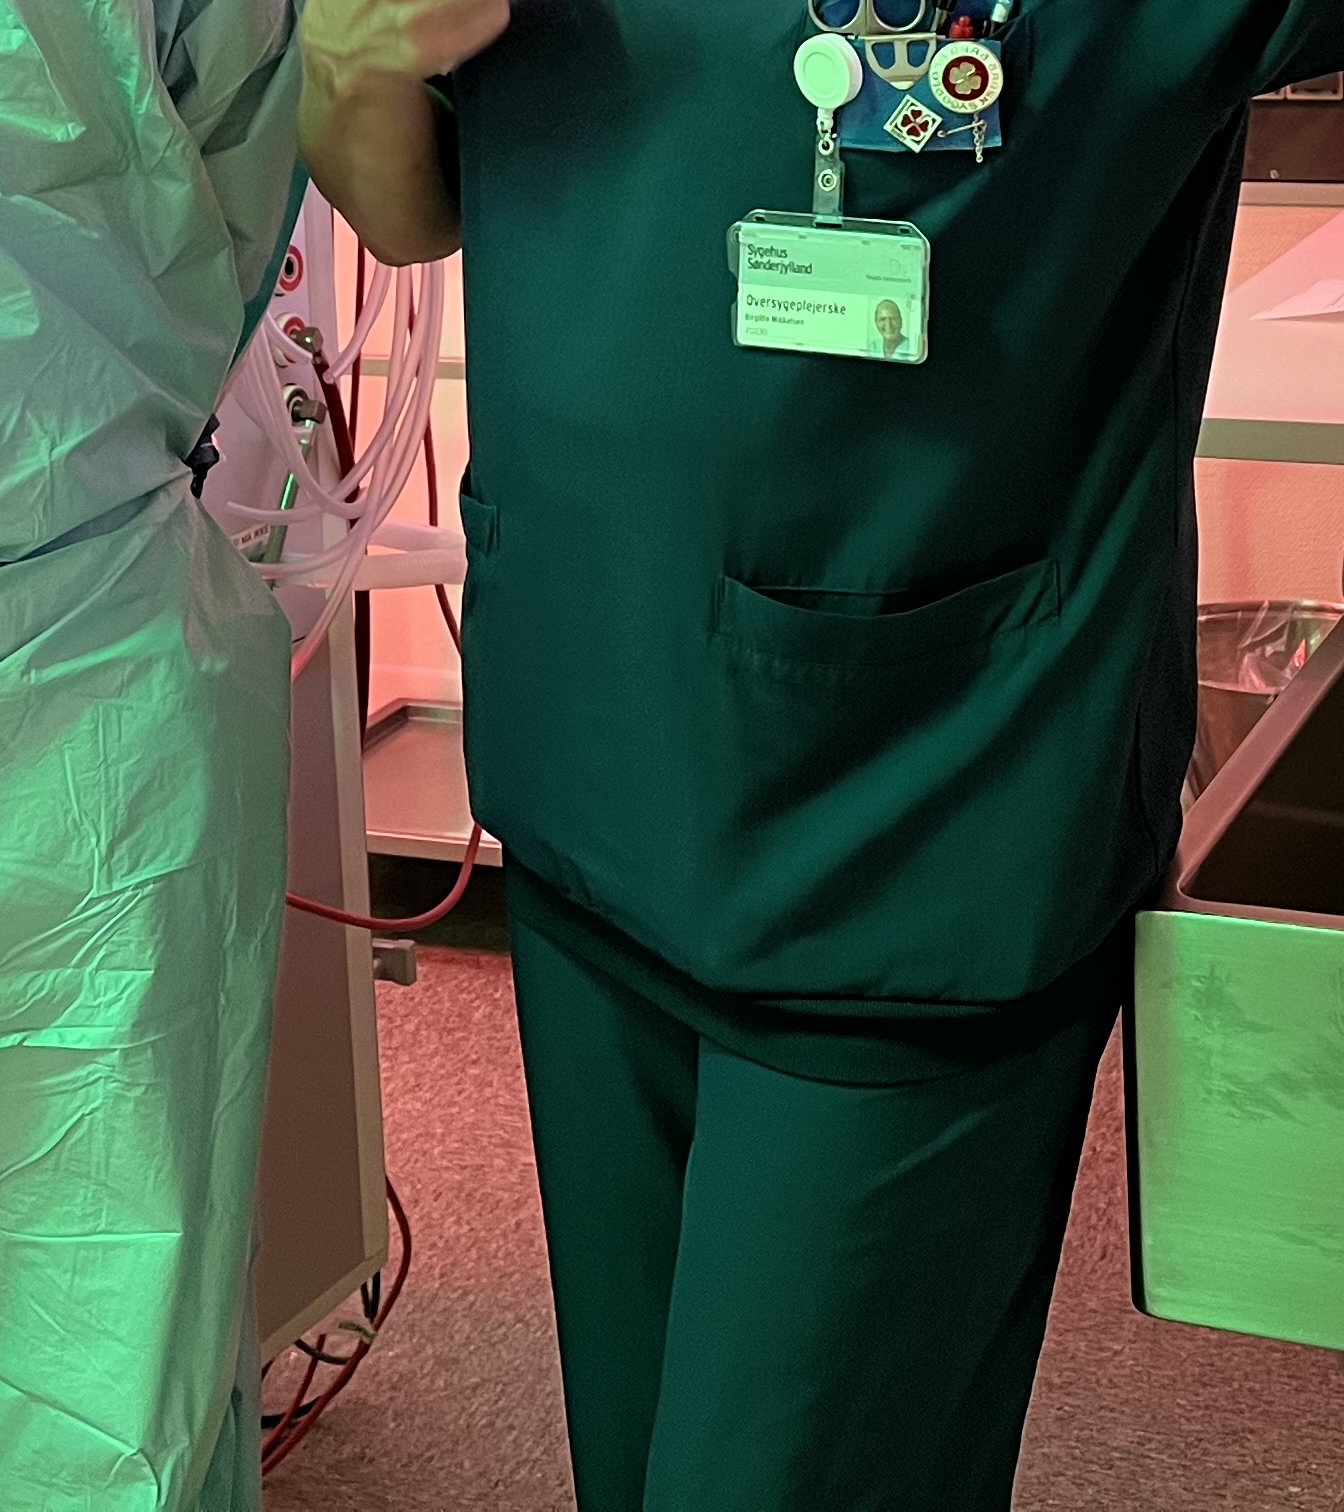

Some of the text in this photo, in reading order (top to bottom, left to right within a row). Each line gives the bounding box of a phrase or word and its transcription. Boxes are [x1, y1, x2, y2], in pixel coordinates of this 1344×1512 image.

[747, 243, 788, 259] Sygehus
[747, 257, 813, 275] Sønderjylland
[746, 294, 847, 315] Oversygeplejerske
